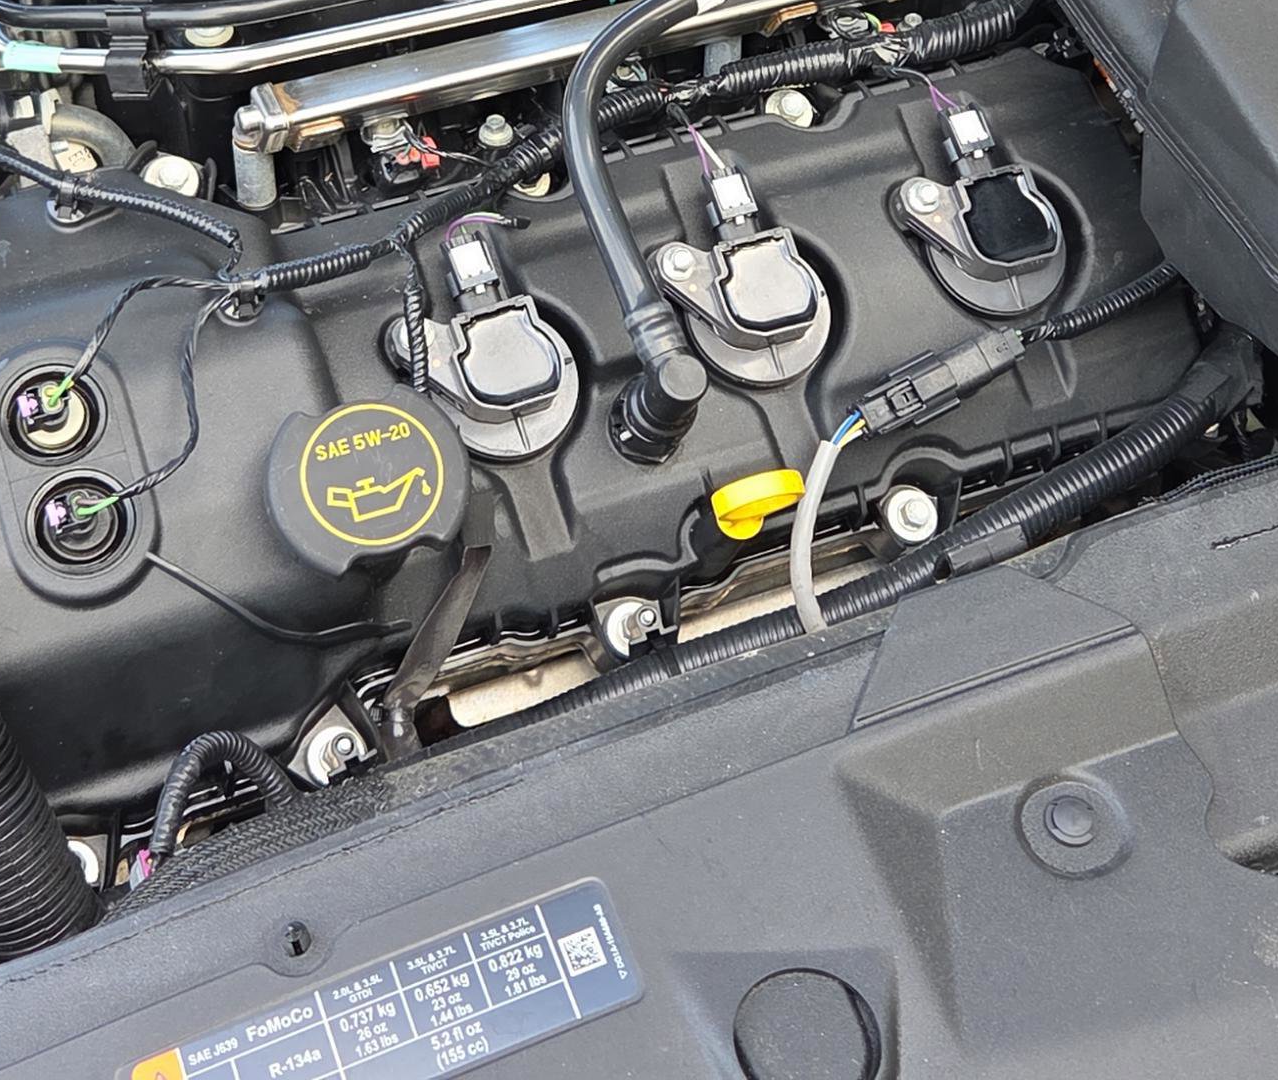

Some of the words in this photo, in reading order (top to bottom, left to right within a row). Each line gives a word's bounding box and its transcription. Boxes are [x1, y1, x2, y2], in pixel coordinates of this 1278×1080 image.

[315, 437, 351, 462] SAE
[352, 422, 411, 451] 5W-20
[480, 927, 501, 941] 3.5L
[500, 924, 509, 935] &
[509, 918, 530, 932] 3.7L
[509, 926, 536, 942] Police
[407, 957, 428, 970] 3.5L
[428, 952, 437, 963] &
[437, 946, 457, 960] 3.7L
[488, 949, 525, 973] 0.822
[525, 943, 543, 958] kg
[505, 969, 521, 982] 29
[521, 963, 537, 976] oz
[333, 983, 353, 1000] 2.0L
[353, 981, 361, 992] &
[361, 974, 383, 989] 3.5L
[414, 975, 452, 1002] 0.652
[452, 971, 471, 988] kg
[504, 980, 527, 998] 1.81
[528, 974, 547, 990] lbs
[431, 998, 447, 1012] 23
[448, 993, 463, 1005] oz
[245, 1005, 313, 1042] FoMoCo
[339, 1005, 373, 1032] 0.737
[376, 1001, 397, 1018] kg
[430, 1010, 454, 1028] 1.44
[455, 1004, 473, 1019] lbs
[355, 1039, 379, 1058] 1.63
[379, 1032, 399, 1049] lbs
[357, 1027, 373, 1042] 26
[374, 1022, 389, 1035] oz
[430, 1030, 452, 1051] 5.2
[453, 1026, 465, 1042] fl
[466, 1020, 483, 1037] oz
[187, 1048, 213, 1067] SAE
[212, 1038, 239, 1057] J639
[268, 1046, 323, 1079] R-134a
[435, 1045, 467, 1072] (155
[468, 1036, 491, 1058] cc)
